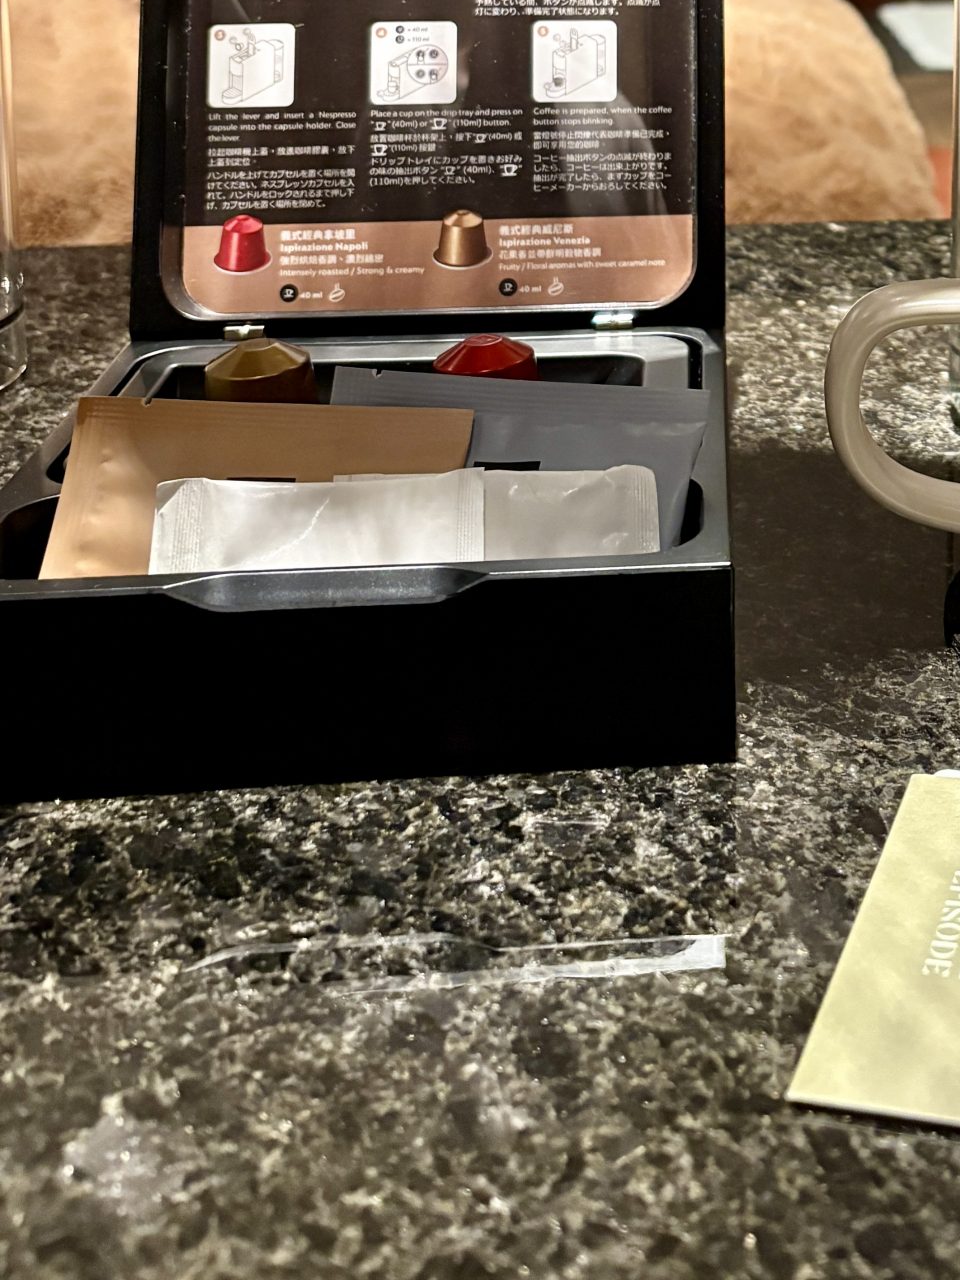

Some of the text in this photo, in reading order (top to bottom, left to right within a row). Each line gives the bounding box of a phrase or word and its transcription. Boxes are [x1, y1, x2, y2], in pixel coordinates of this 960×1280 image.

[208, 112, 222, 121] Lift
[225, 112, 239, 121] the
[242, 112, 261, 120] lever
[264, 111, 280, 120] and
[283, 111, 304, 120] insert
[318, 111, 357, 120] Nespresso
[370, 110, 392, 118] Place
[398, 111, 414, 119] cup
[426, 109, 440, 117] the
[441, 109, 458, 118] drip
[457, 110, 474, 118] tray
[474, 109, 491, 117] and
[533, 106, 561, 115] Coffee
[610, 106, 632, 114] when
[633, 106, 648, 114] the
[208, 122, 238, 132] capsule
[240, 122, 256, 131] into
[258, 122, 272, 131] the
[274, 122, 304, 131] capsule
[335, 121, 356, 129] Close
[533, 118, 559, 126] button
[560, 118, 582, 127] stops
[280, 241, 369, 253] Ispirazione Napoli
[499, 235, 591, 248] Ispirazione Venezia
[499, 262, 520, 272] Fruity
[526, 261, 548, 270] Floral
[577, 260, 594, 268] with
[618, 259, 648, 268] caramel
[648, 259, 666, 267] note
[280, 268, 317, 277] Intensely
[318, 267, 350, 276] roasted
[356, 266, 385, 276] Strong
[394, 267, 425, 276] creamy
